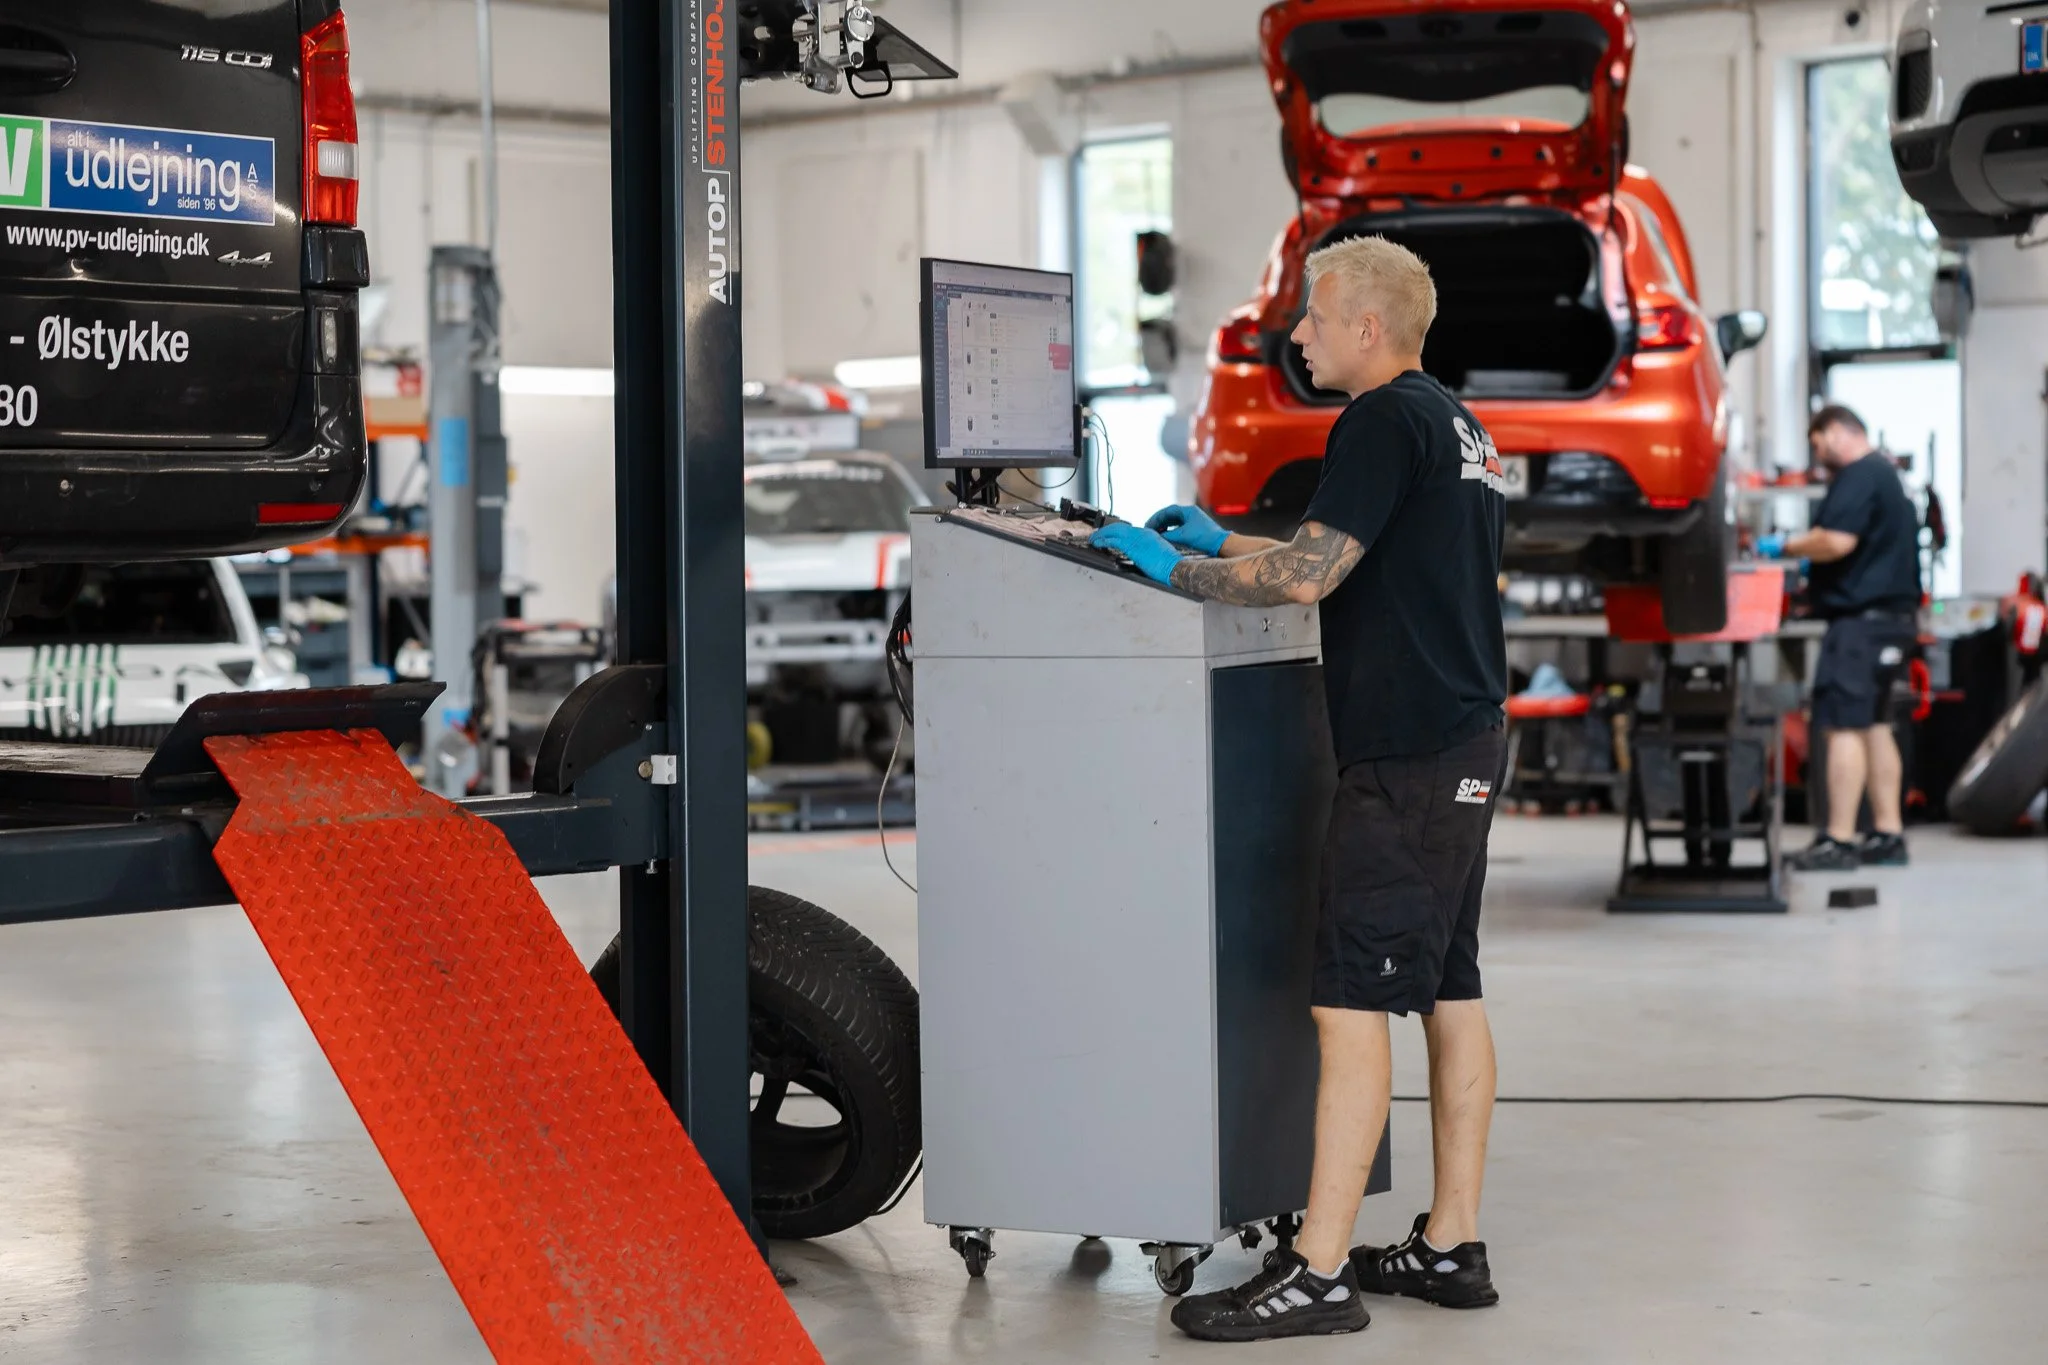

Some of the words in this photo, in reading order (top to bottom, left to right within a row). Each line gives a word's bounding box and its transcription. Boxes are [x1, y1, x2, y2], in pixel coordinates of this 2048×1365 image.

[181, 44, 220, 62] 116
[67, 131, 83, 148] alt
[66, 137, 241, 212] udlejning
[177, 198, 200, 210] siden
[6, 225, 210, 260] www.pv-udlejning.dk
[708, 177, 727, 304] AUTOP
[217, 250, 273, 269] 4x4
[38, 314, 190, 370] Ølstykke
[1456, 777, 1481, 796] SP
